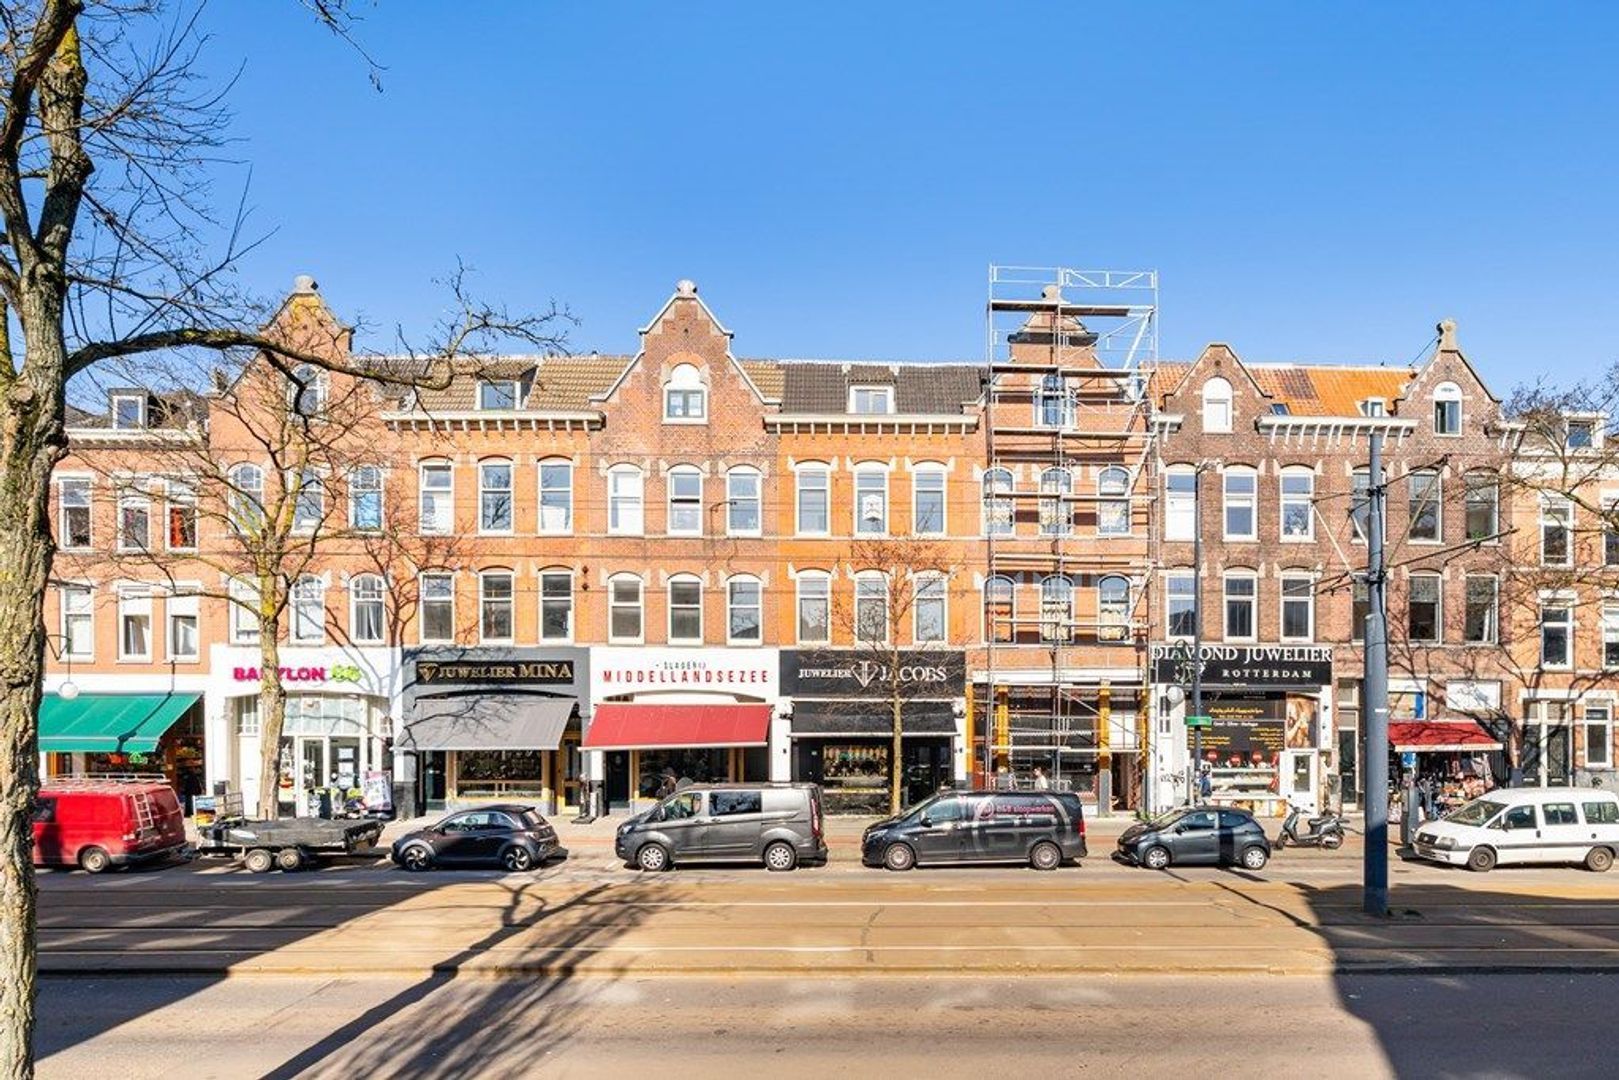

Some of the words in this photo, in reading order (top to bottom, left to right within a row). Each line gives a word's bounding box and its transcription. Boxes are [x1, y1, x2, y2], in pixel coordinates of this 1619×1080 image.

[1244, 647, 1332, 664] JUWELIER
[234, 667, 326, 681] BAYLON
[438, 665, 516, 678] JUWELIER
[518, 664, 573, 678] MINA
[603, 670, 768, 683] MIDDELLANDSEZEE
[798, 668, 851, 678] JUWELIER
[1222, 669, 1312, 678] ROTTERDAM
